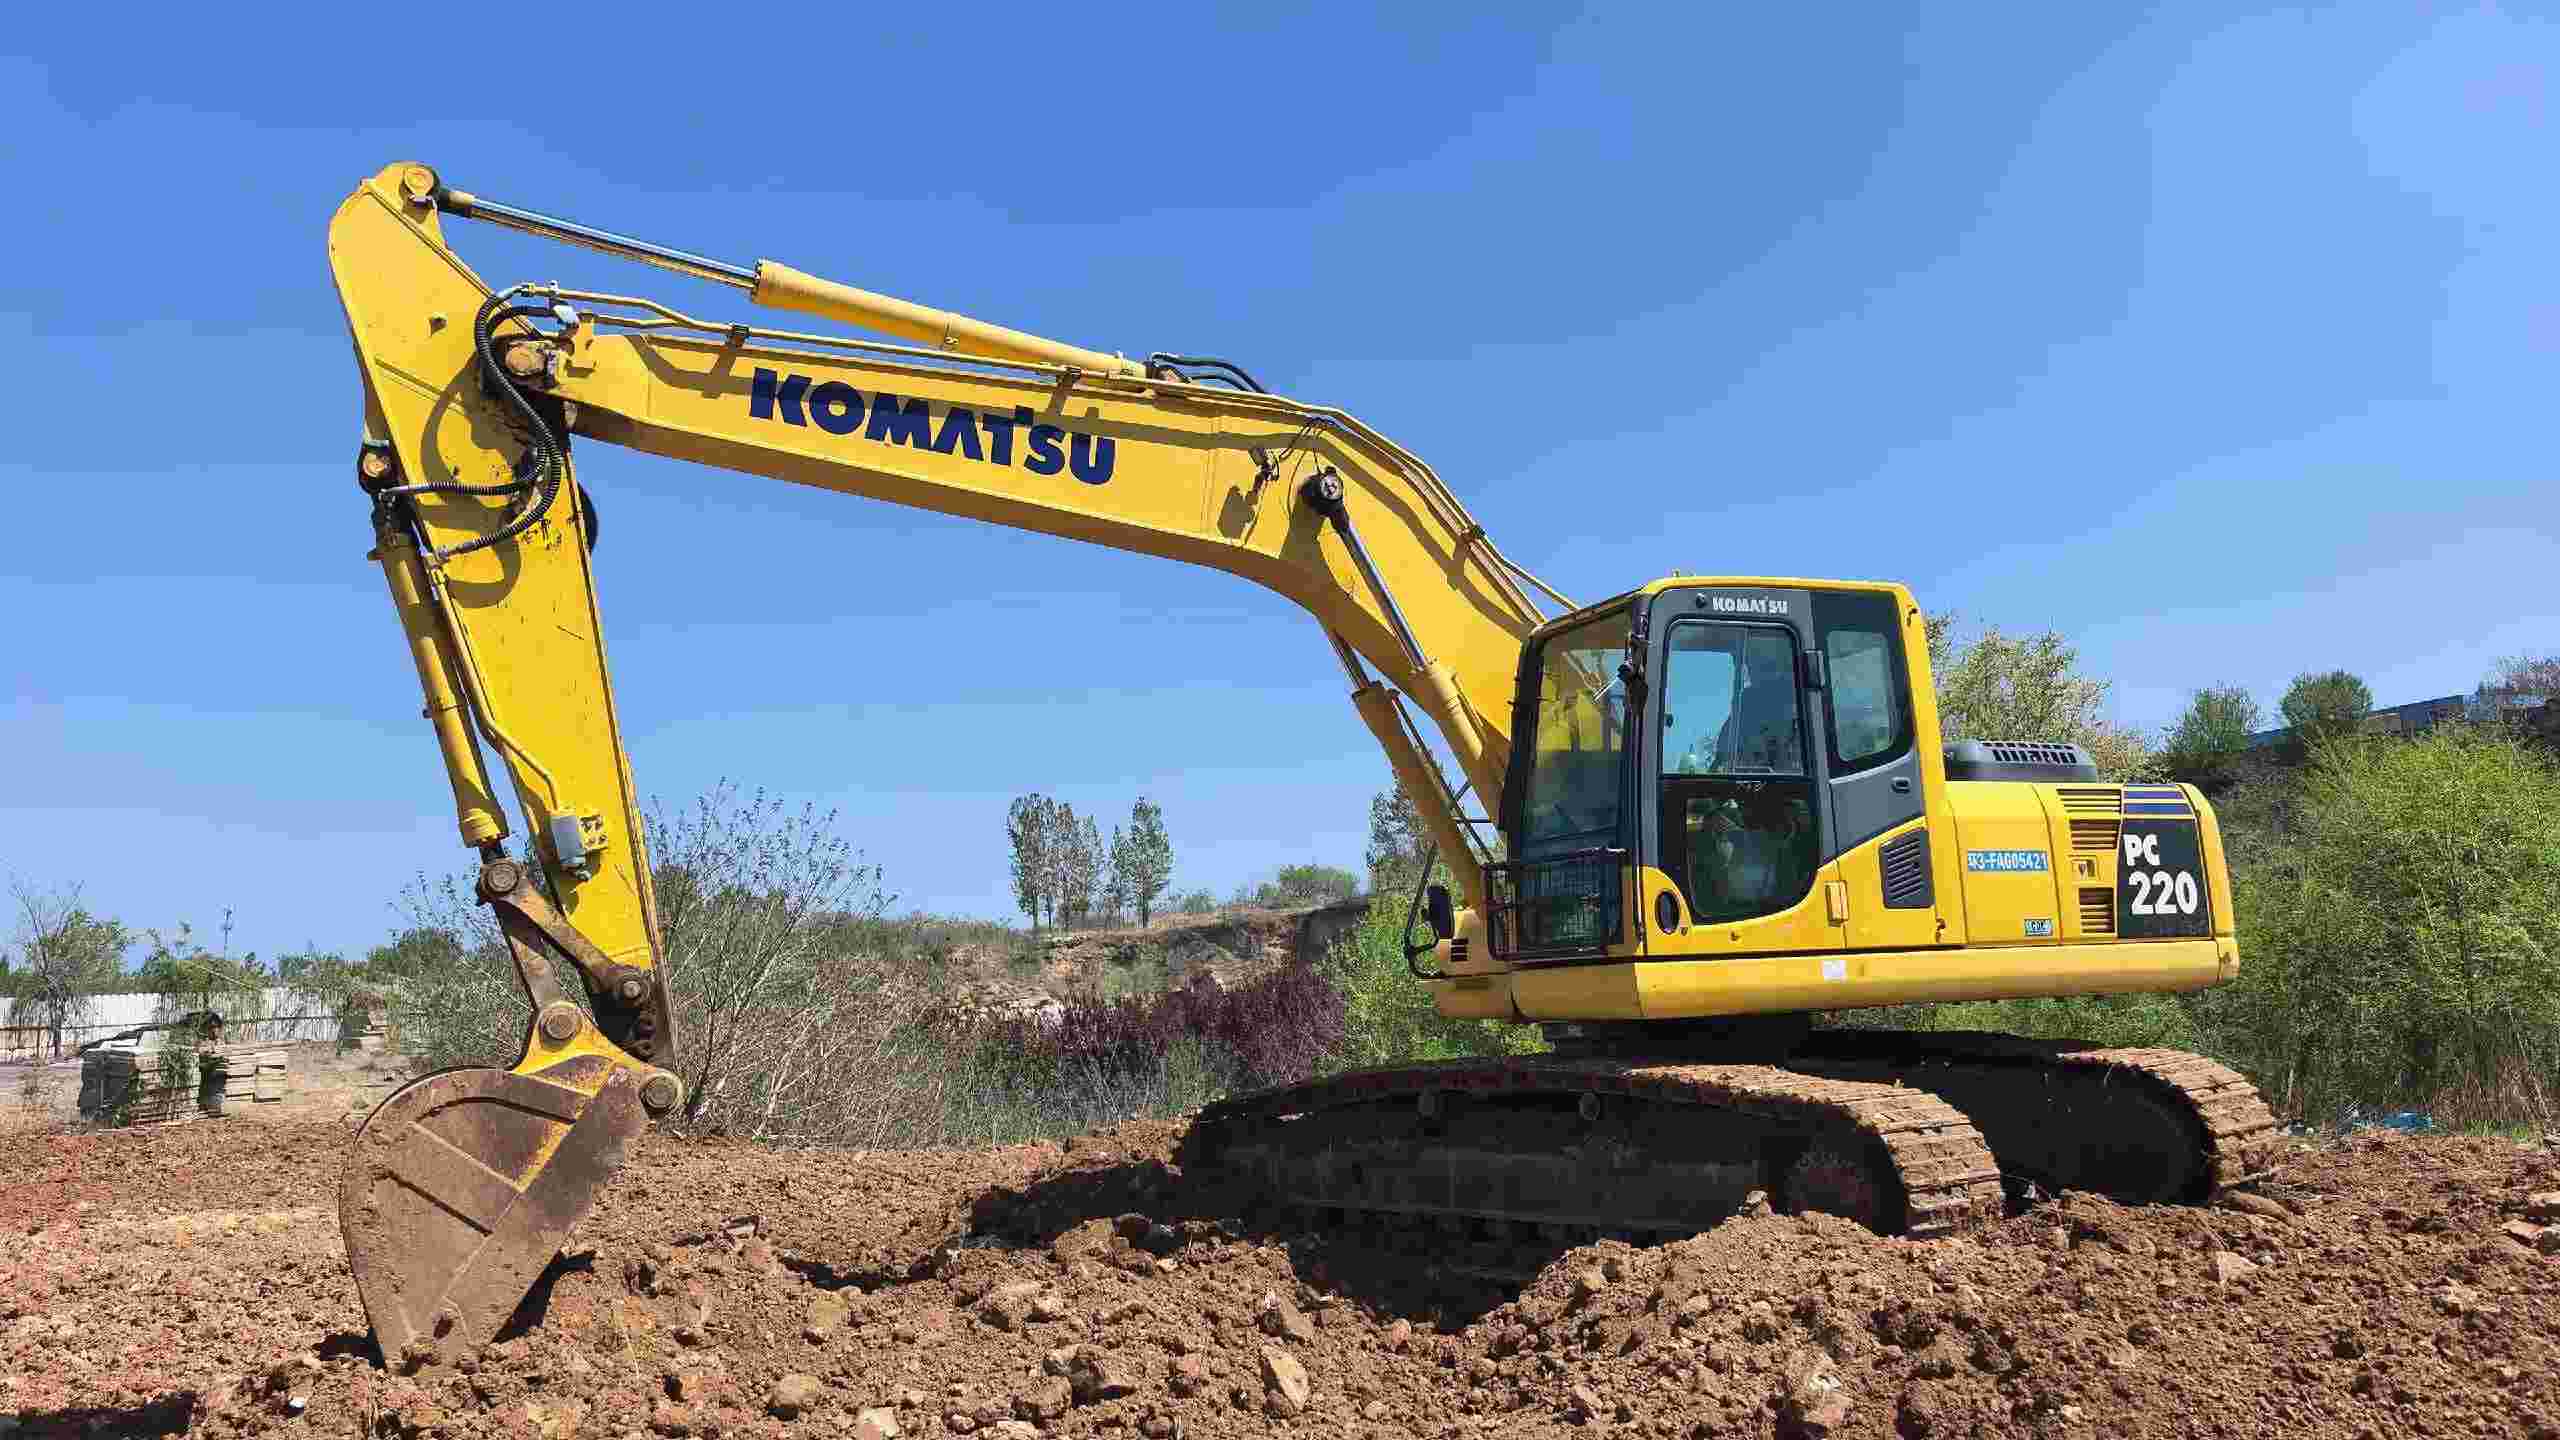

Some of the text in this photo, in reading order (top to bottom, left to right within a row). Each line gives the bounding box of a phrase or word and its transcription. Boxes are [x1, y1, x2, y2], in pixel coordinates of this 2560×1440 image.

[749, 367, 1116, 485] KOMATSU
[1712, 596, 1788, 614] KOMATSU
[2123, 834, 2160, 866] PC
[2128, 871, 2198, 914] 220
